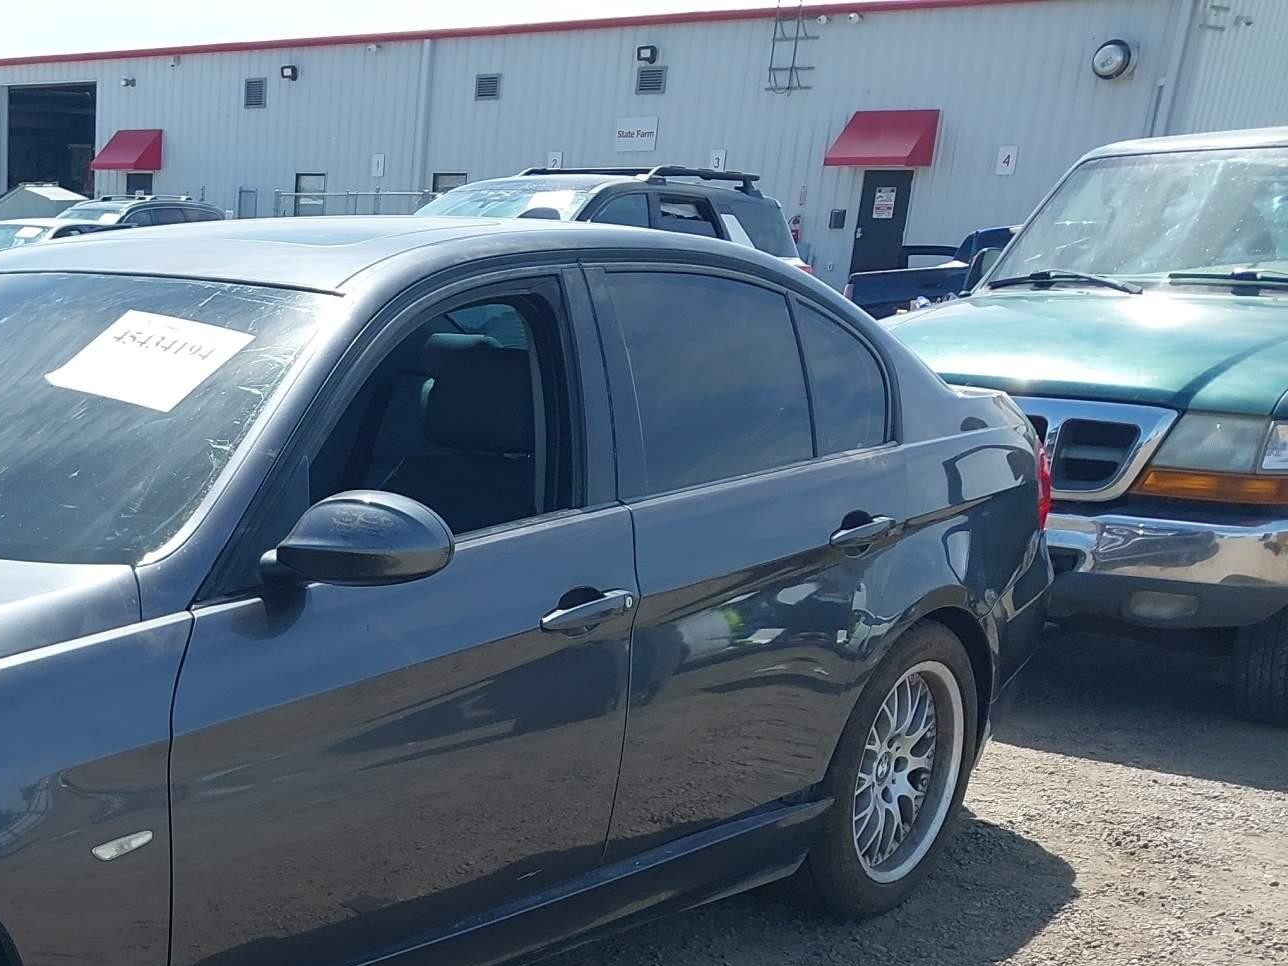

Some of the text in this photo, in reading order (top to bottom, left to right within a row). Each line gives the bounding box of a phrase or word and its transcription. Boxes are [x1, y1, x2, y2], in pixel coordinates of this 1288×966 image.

[616, 129, 655, 139] State Farm
[551, 157, 558, 168] 2
[714, 156, 720, 169] 3
[1002, 153, 1011, 167] 4
